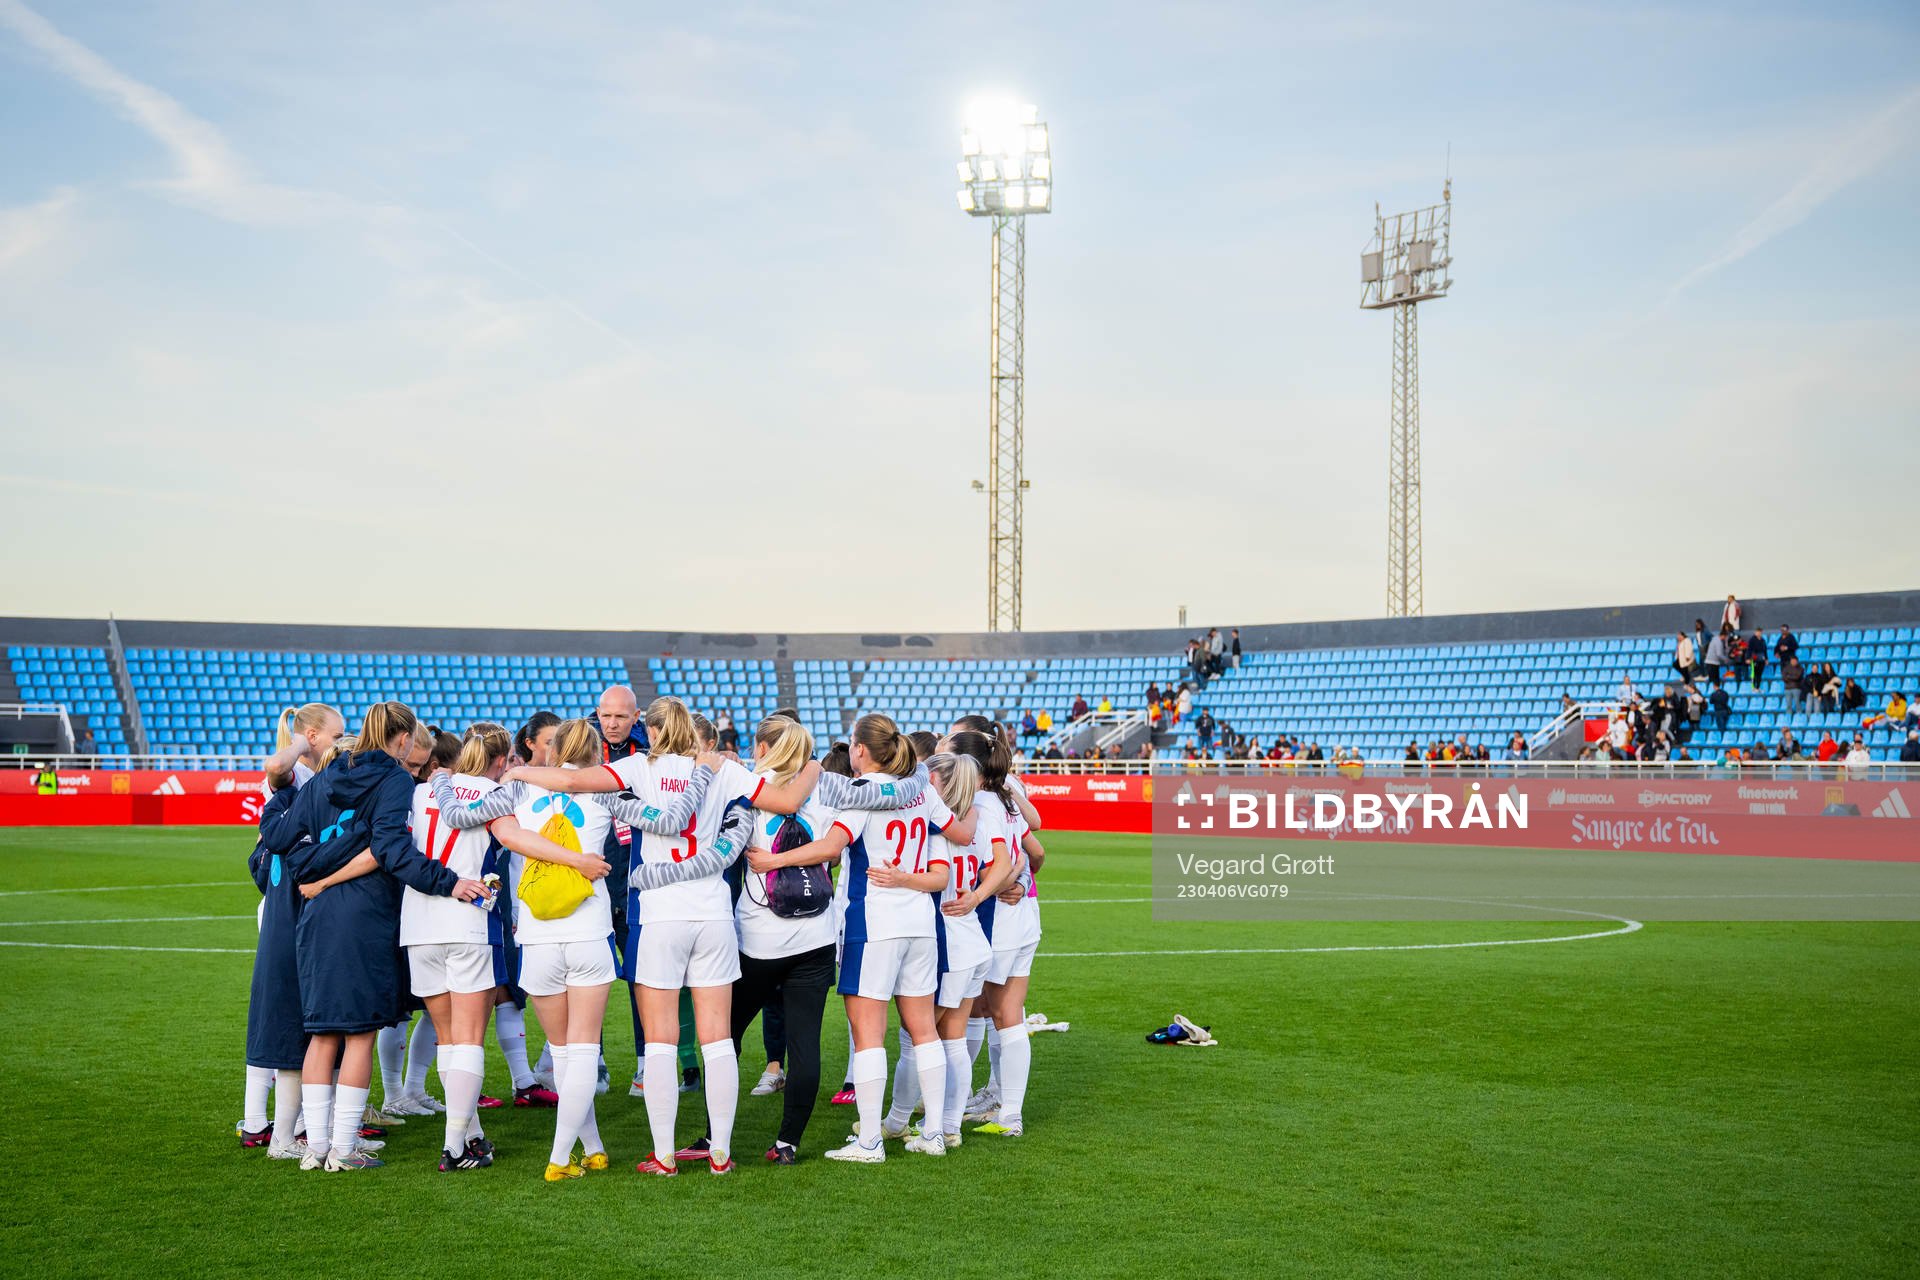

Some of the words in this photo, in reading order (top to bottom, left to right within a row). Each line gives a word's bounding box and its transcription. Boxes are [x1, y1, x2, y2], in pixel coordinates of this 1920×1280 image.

[1738, 786, 1798, 799] finetwork
[671, 811, 697, 863] 3
[1571, 813, 1644, 849] Sangre
[1650, 817, 1672, 843] de
